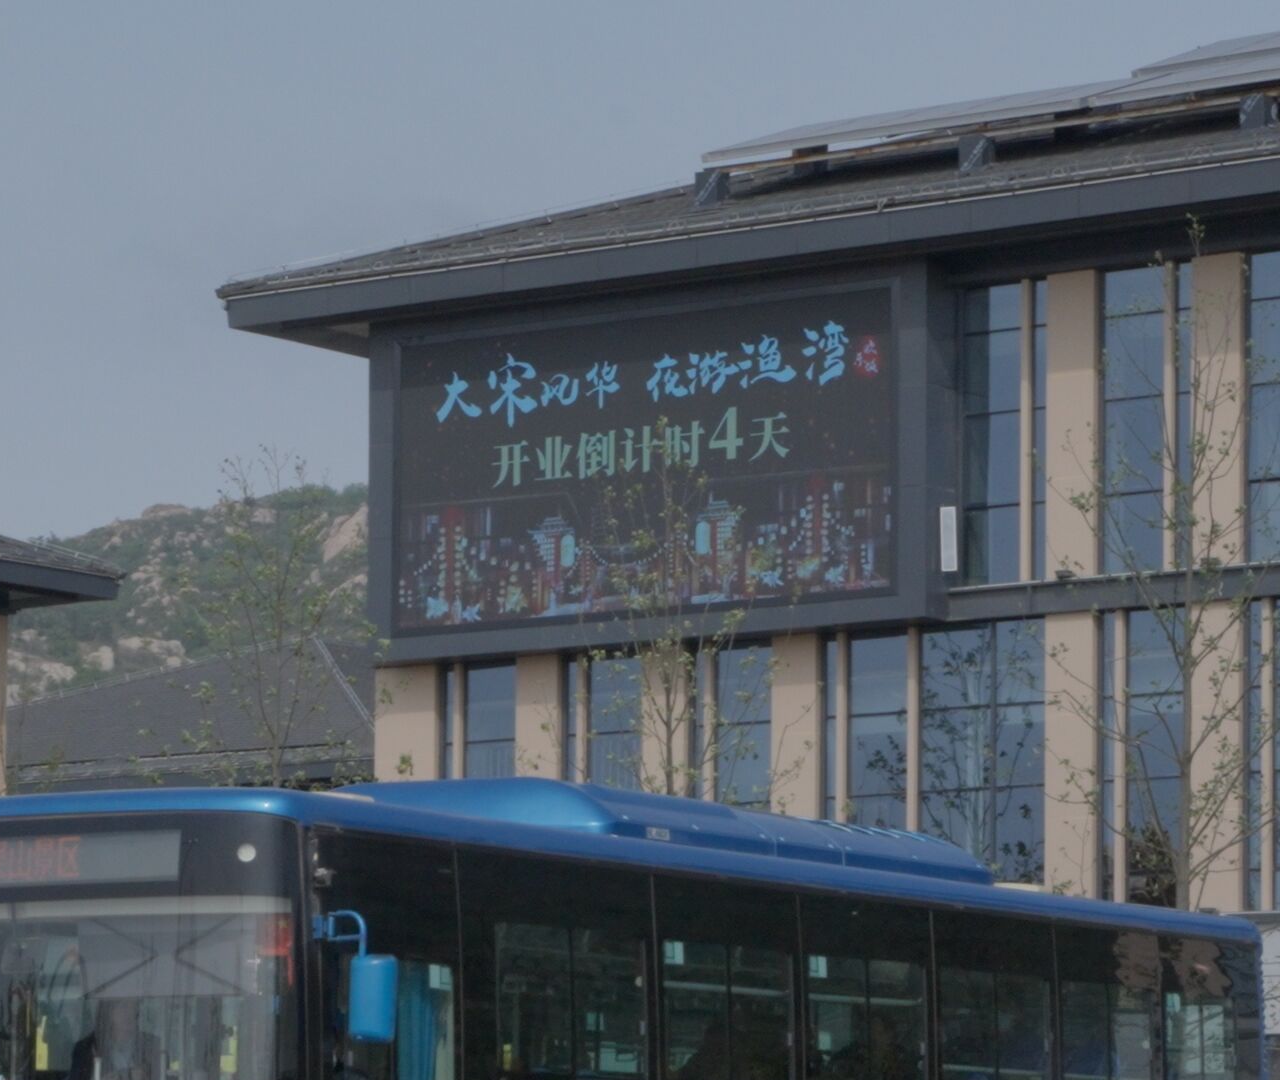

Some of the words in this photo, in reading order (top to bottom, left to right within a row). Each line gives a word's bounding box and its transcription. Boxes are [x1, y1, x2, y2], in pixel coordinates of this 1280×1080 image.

[436, 353, 620, 428] 大宋风华
[646, 320, 849, 402] 夜游渔湾
[491, 406, 790, 489] 开业倒计时4天
